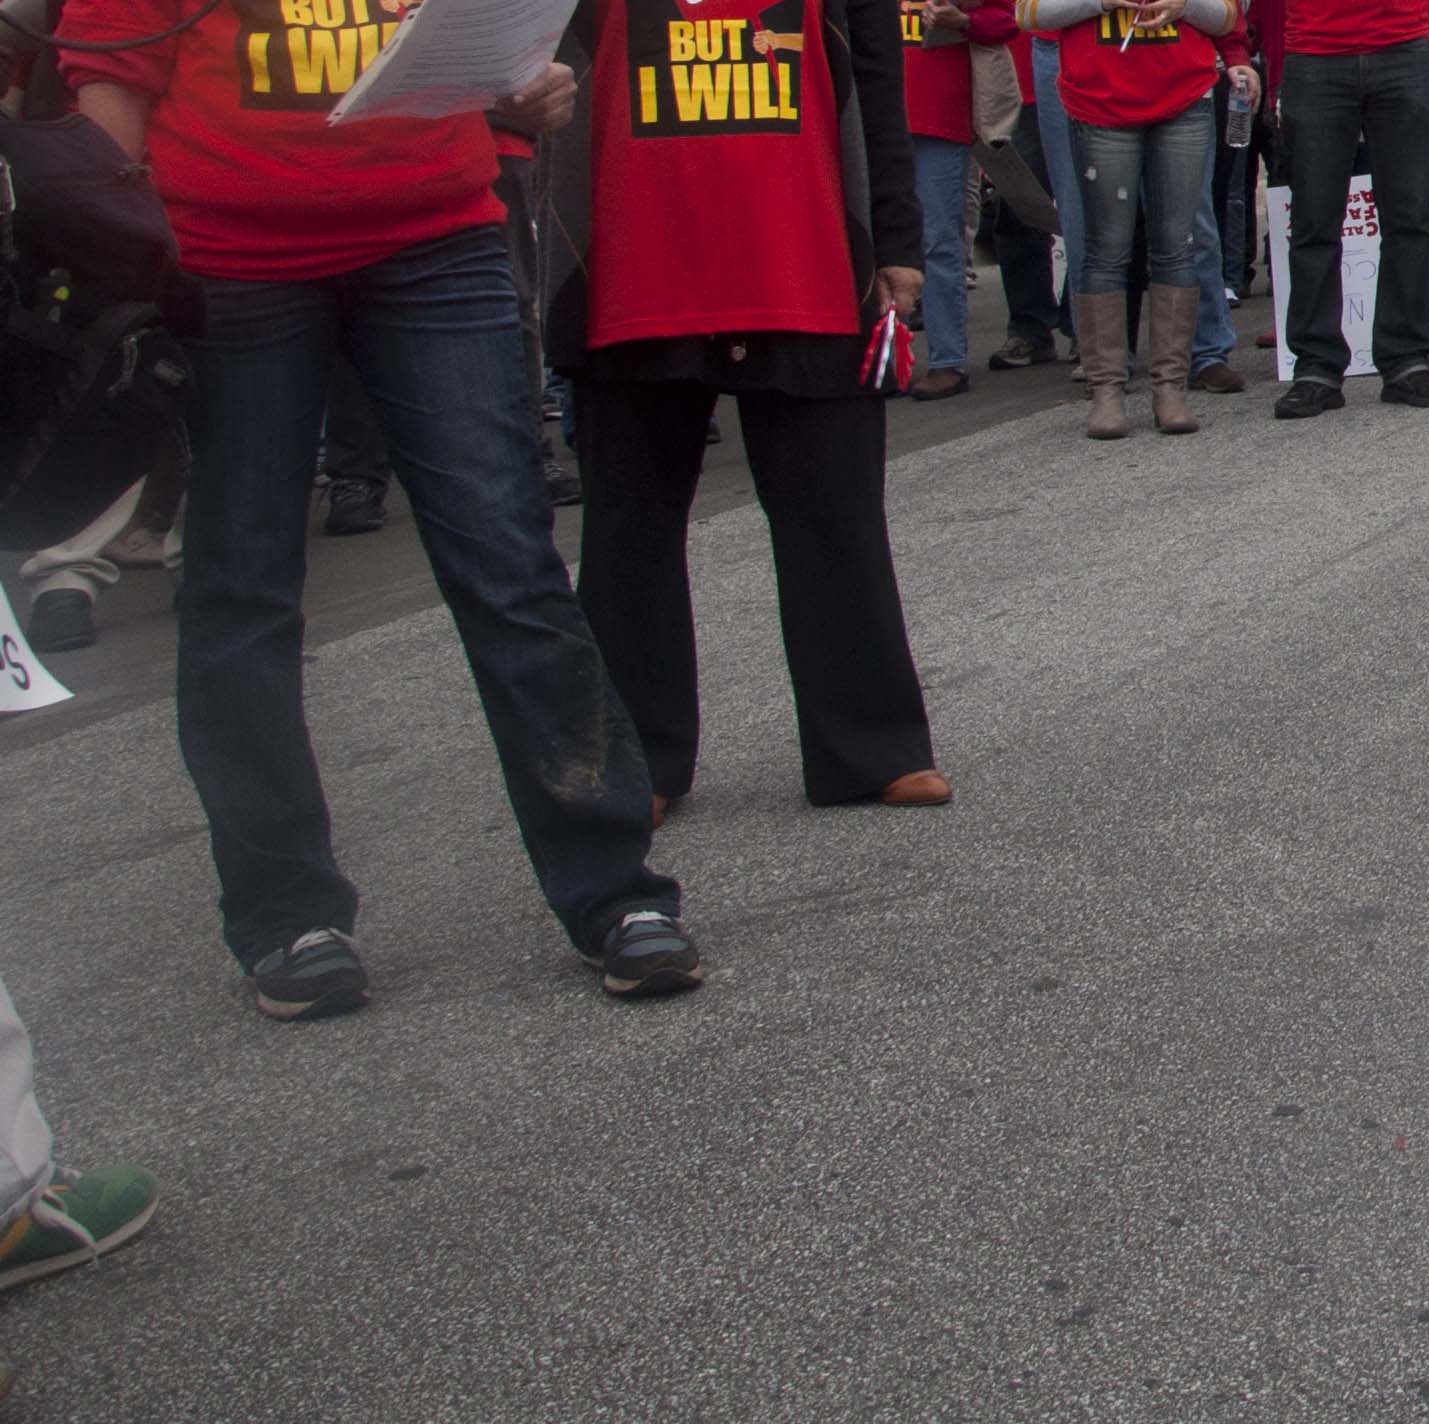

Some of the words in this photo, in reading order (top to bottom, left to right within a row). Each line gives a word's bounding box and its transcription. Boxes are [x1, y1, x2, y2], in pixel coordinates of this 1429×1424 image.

[248, 33, 271, 93] I
[287, 22, 401, 94] WI
[668, 19, 747, 62] BUT
[639, 66, 658, 123] I
[671, 62, 797, 121] WILL
